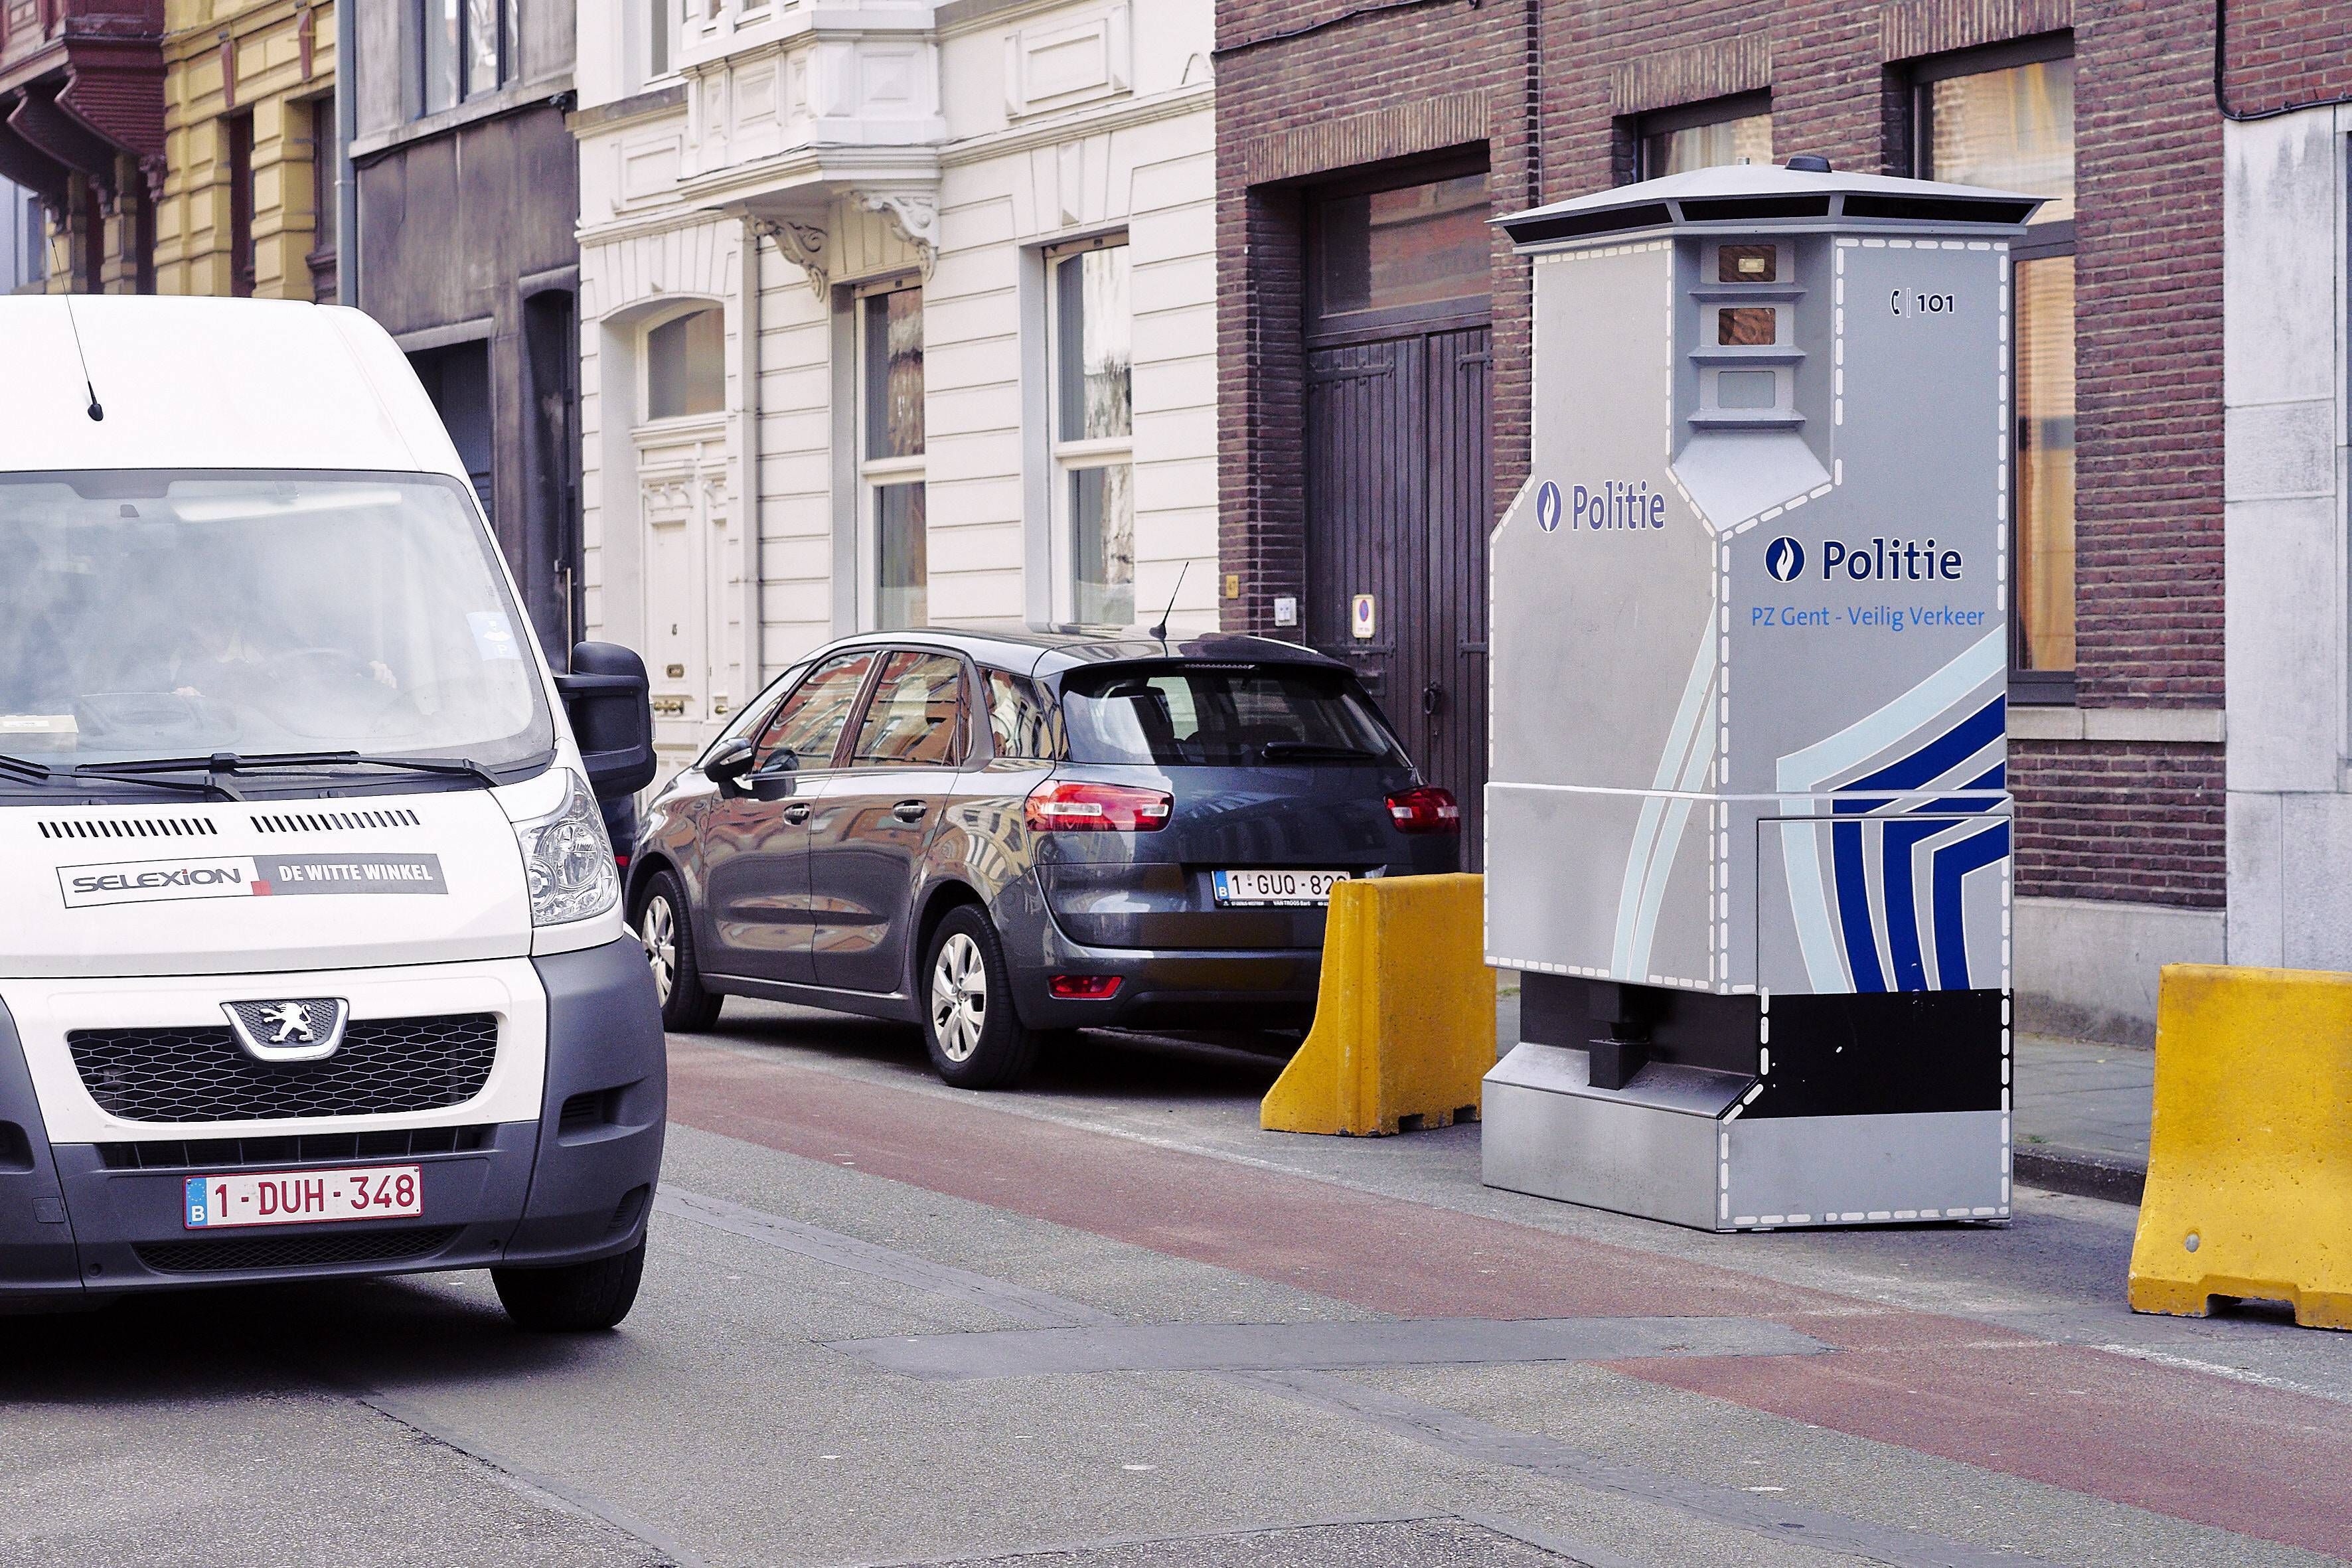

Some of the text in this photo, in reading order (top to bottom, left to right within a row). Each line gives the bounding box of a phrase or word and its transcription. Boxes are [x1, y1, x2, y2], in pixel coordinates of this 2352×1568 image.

[1917, 293, 1954, 313] 101
[1573, 480, 1665, 530] Politie
[1823, 538, 1963, 581] Politie
[1751, 606, 1775, 626] PZ
[1781, 605, 1830, 626] Gent
[1847, 605, 1905, 632] Veilig
[1909, 605, 1985, 627] Verkeer
[278, 864, 433, 882] DE WITTE WINKEL
[1219, 886, 1228, 897] B
[1231, 874, 1347, 895] 1-GUQ-82
[215, 1174, 414, 1217] 1-DUH-348
[191, 1205, 205, 1222] B
